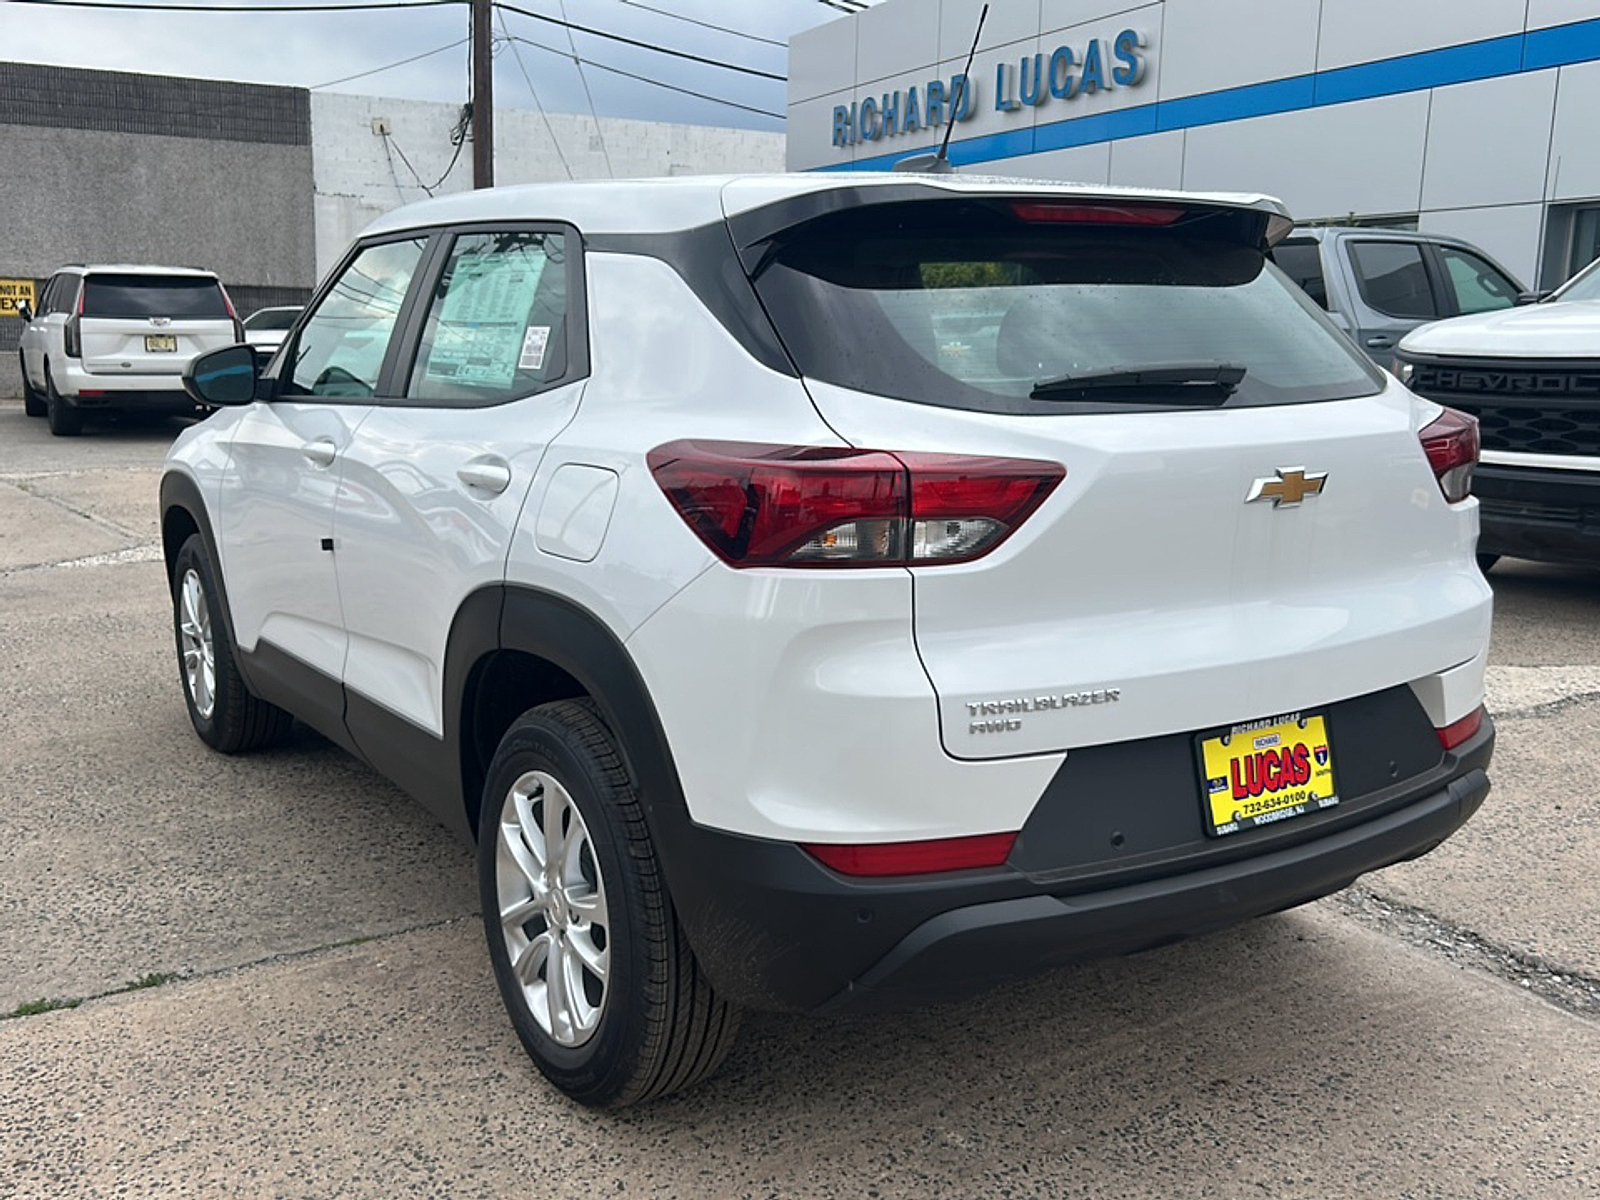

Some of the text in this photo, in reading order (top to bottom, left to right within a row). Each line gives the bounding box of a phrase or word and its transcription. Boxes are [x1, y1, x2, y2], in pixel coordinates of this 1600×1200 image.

[832, 28, 1147, 148] RICHARD LUCAS
[20, 284, 31, 296] AN
[1, 297, 31, 310] EXT
[966, 688, 1121, 716] TRAILBLAZER
[969, 718, 1022, 734] AWD
[1232, 713, 1300, 734] RICHARD LUCAS
[1231, 743, 1311, 800] LUCAS
[1243, 791, 1306, 814] 732-634-0100
